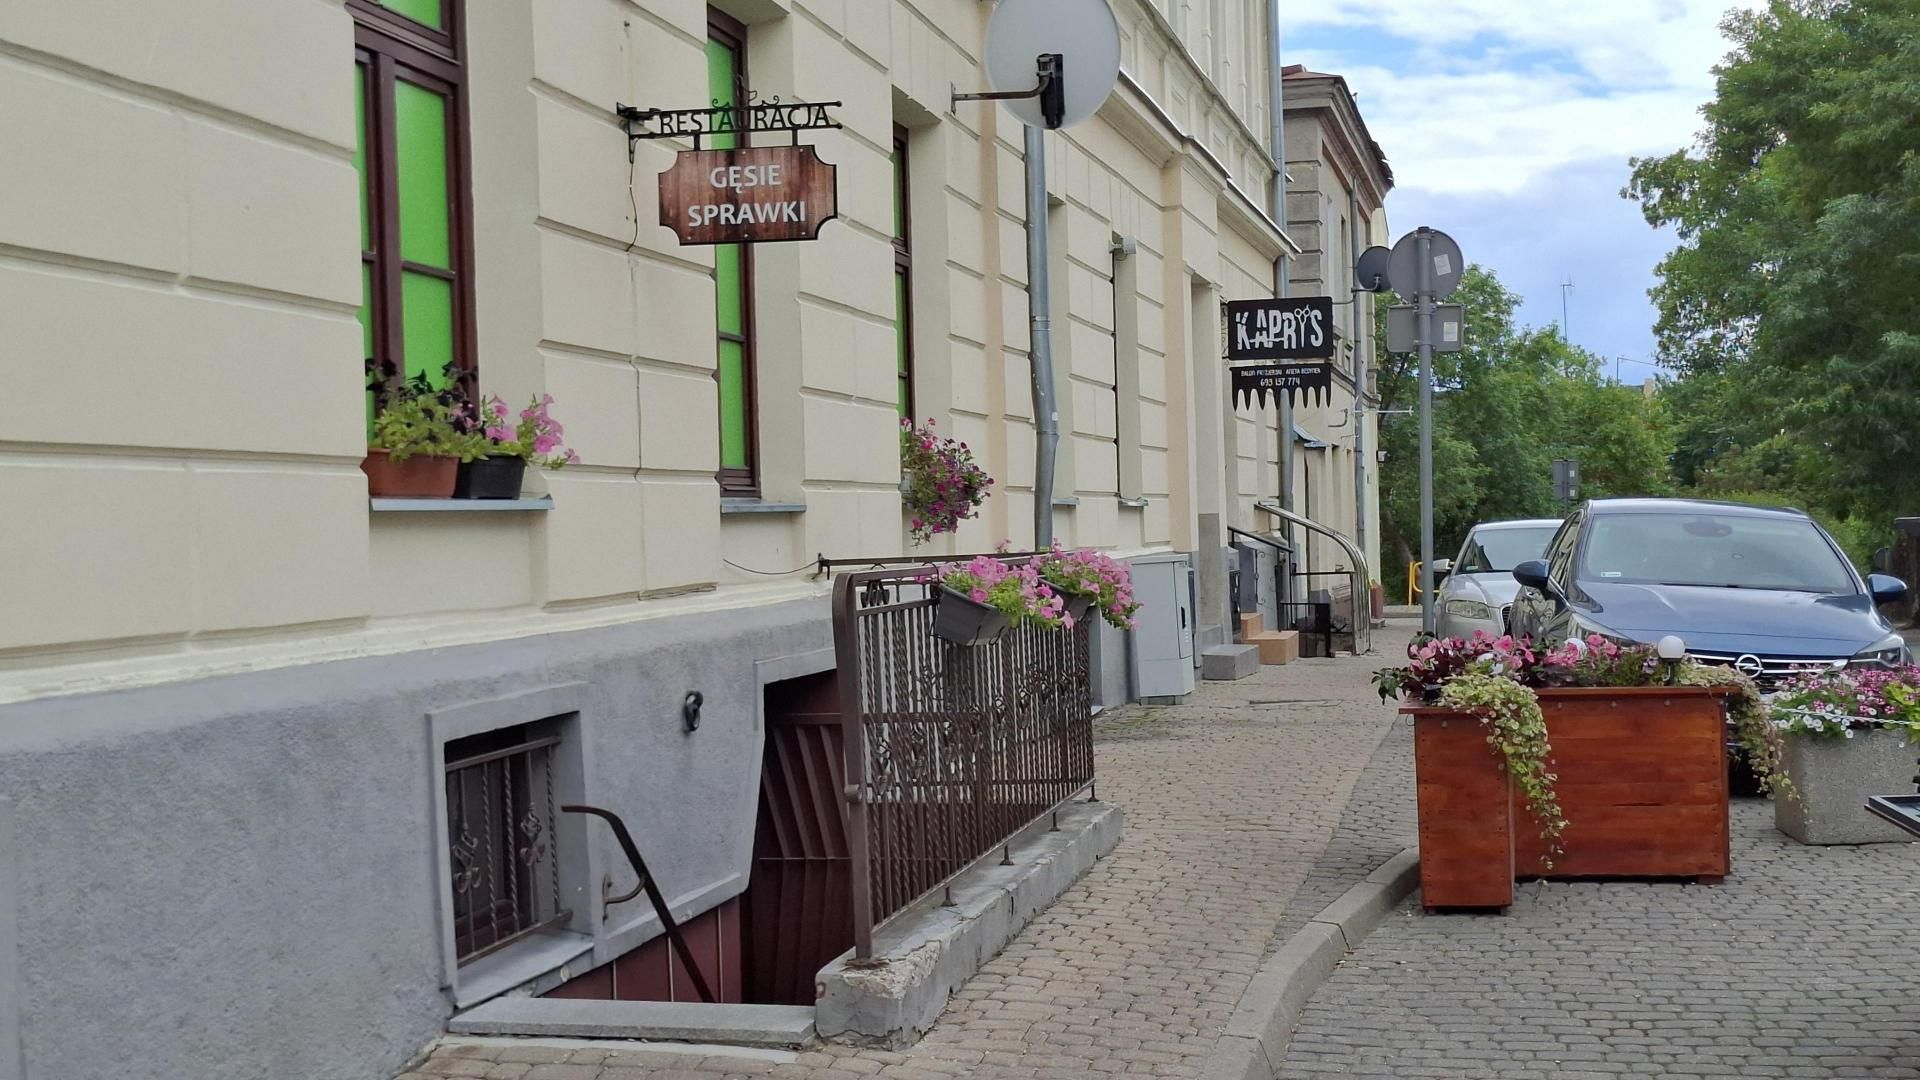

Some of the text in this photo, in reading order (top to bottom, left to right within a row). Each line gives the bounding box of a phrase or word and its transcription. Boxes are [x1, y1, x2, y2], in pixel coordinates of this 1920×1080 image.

[710, 164, 782, 194] GĘSIE
[687, 200, 806, 227] SPRAWKI
[1235, 304, 1323, 350] KAPRYS
[1260, 378, 1273, 386] 693
[1287, 376, 1300, 386] 774
